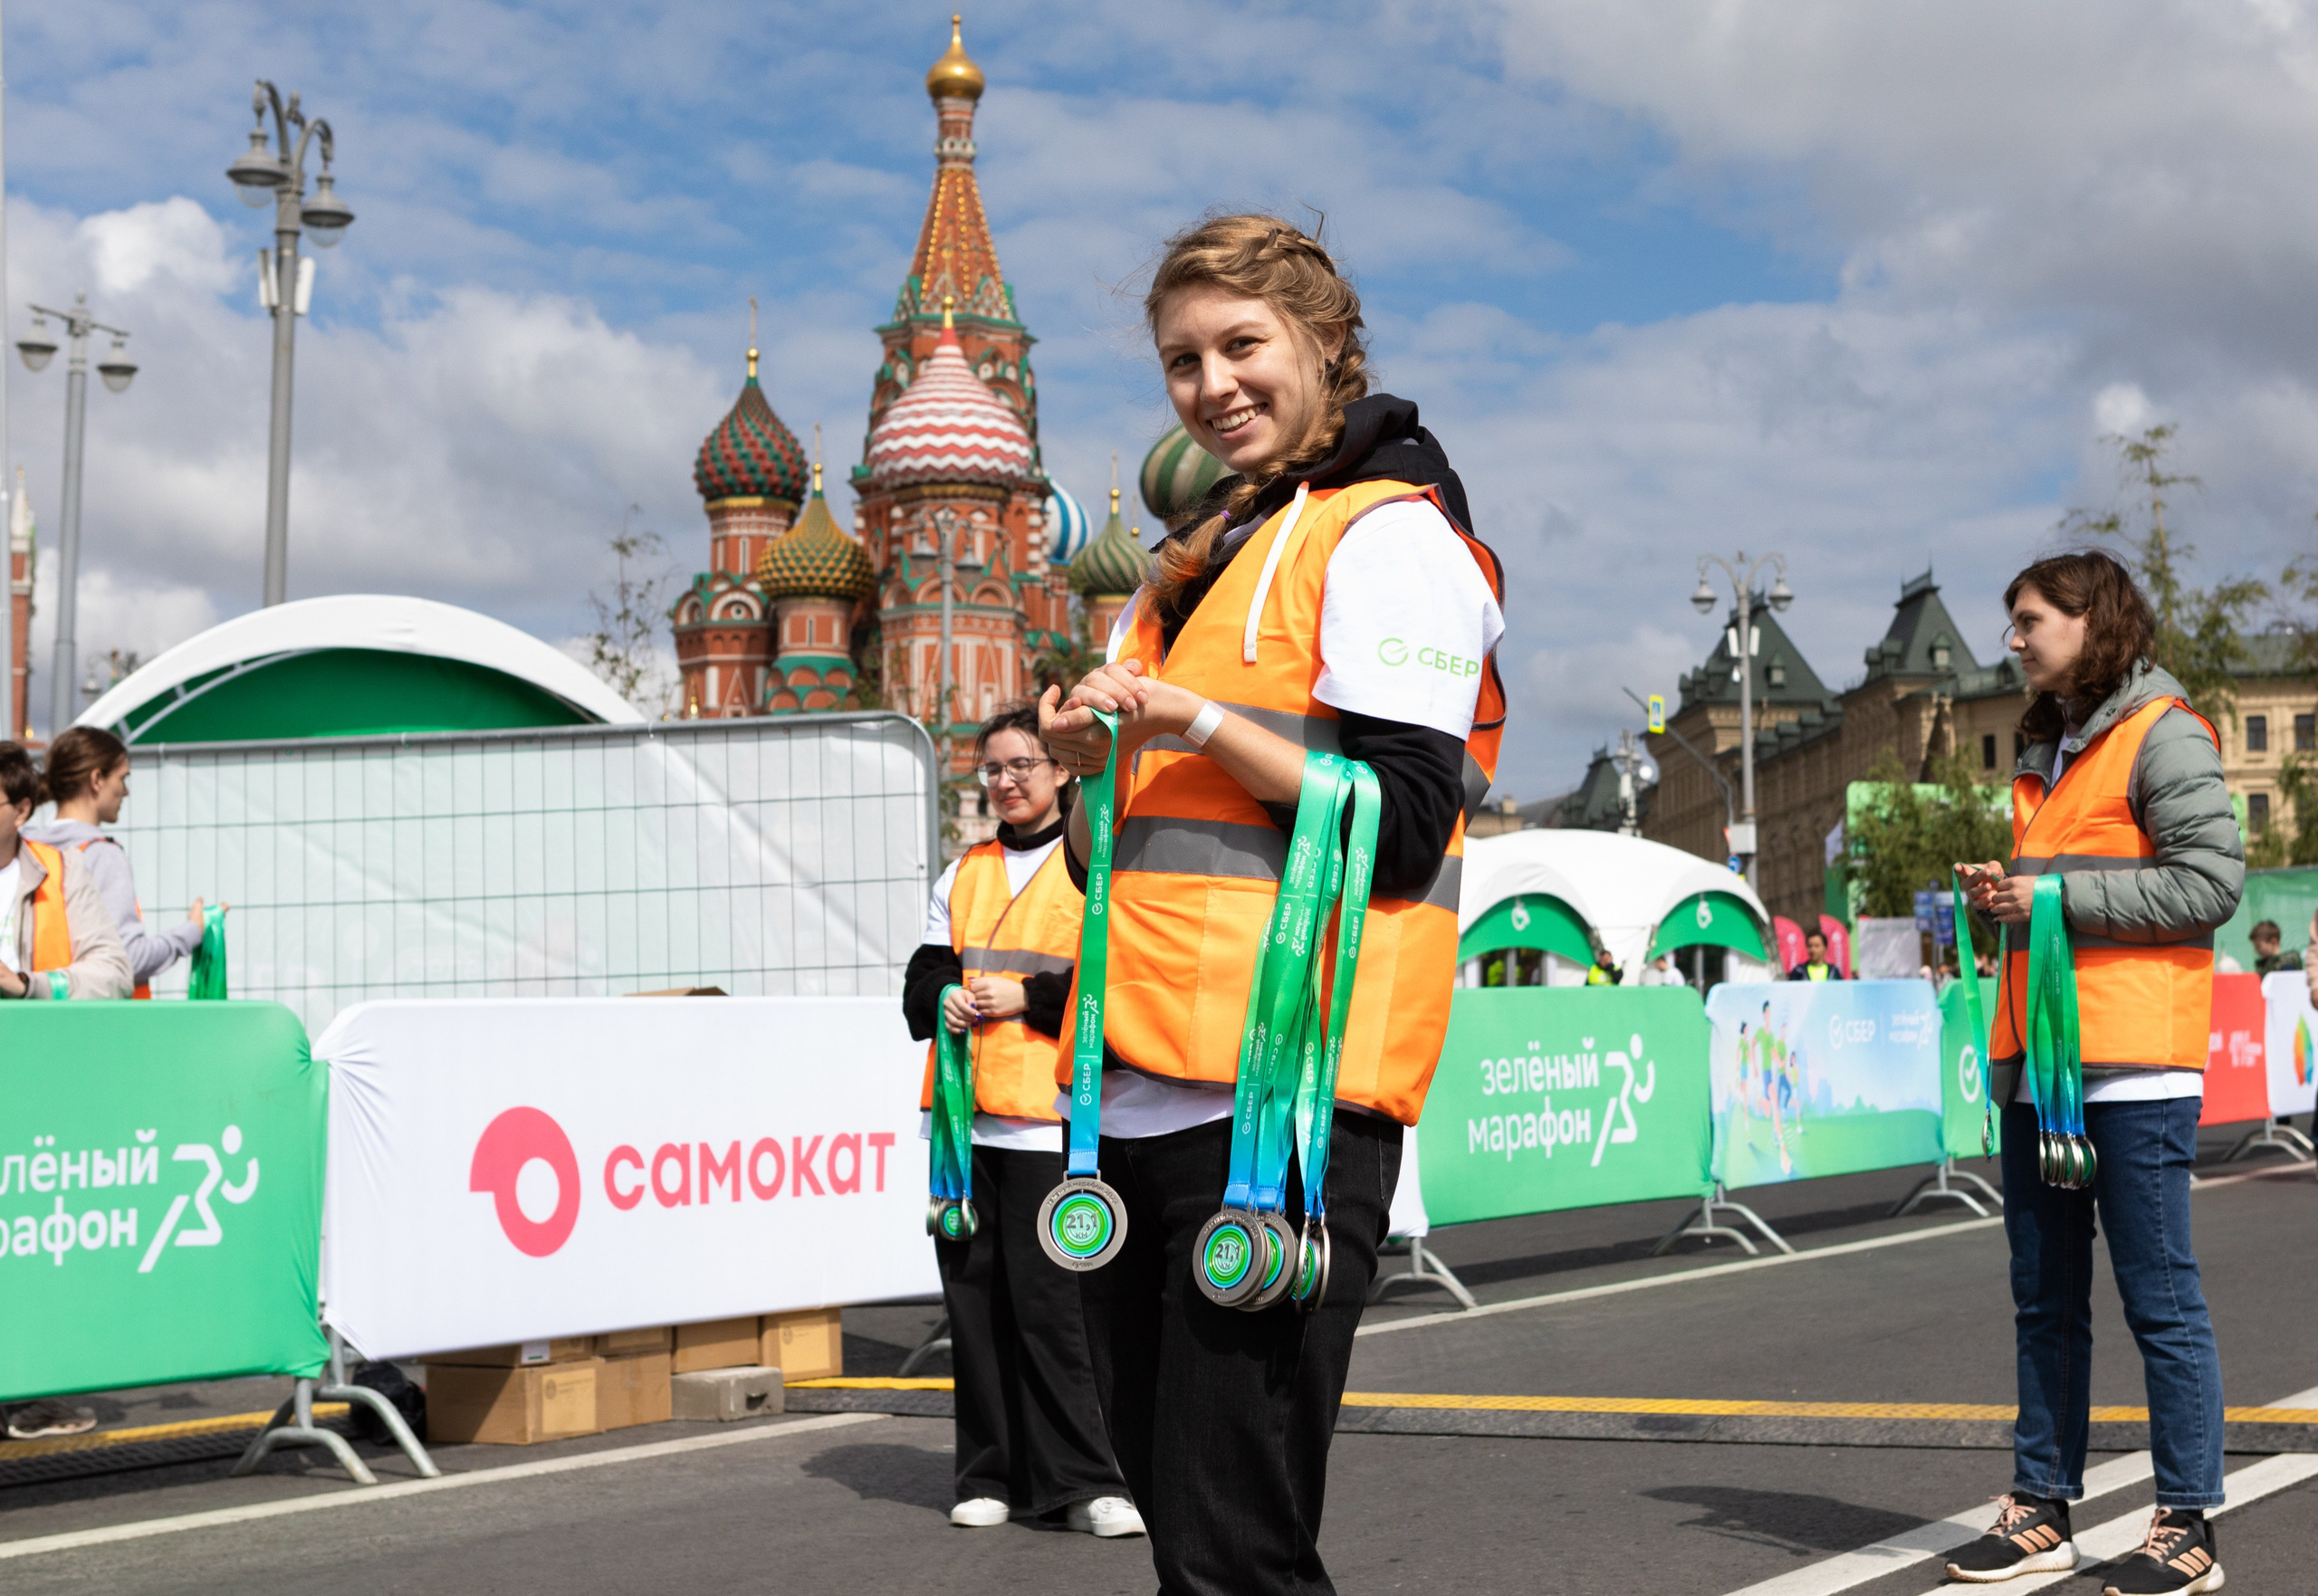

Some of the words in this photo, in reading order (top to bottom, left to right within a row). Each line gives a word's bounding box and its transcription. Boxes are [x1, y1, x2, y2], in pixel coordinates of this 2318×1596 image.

[1417, 646, 1480, 678] СБЕР
[1102, 822, 1110, 858] марафон
[1095, 872, 1104, 901] СБЕР
[1293, 855, 1307, 889] марафон
[1331, 864, 1339, 892] СБЕР
[1279, 902, 1292, 931] СБЕР
[1351, 915, 1360, 944] СБЕР
[1082, 1009, 1090, 1044] зелёный
[1089, 1013, 1097, 1049] марафон
[1082, 1063, 1092, 1092] СБЕР
[1306, 1056, 1314, 1085] СБЕР
[1480, 1036, 1600, 1095] зелёный
[1245, 1091, 1254, 1120] СБЕР
[1468, 1094, 1591, 1162] марафон
[603, 1132, 896, 1211] самокат
[1067, 1213, 1098, 1231] 21,1
[1215, 1243, 1241, 1261] 21,1
